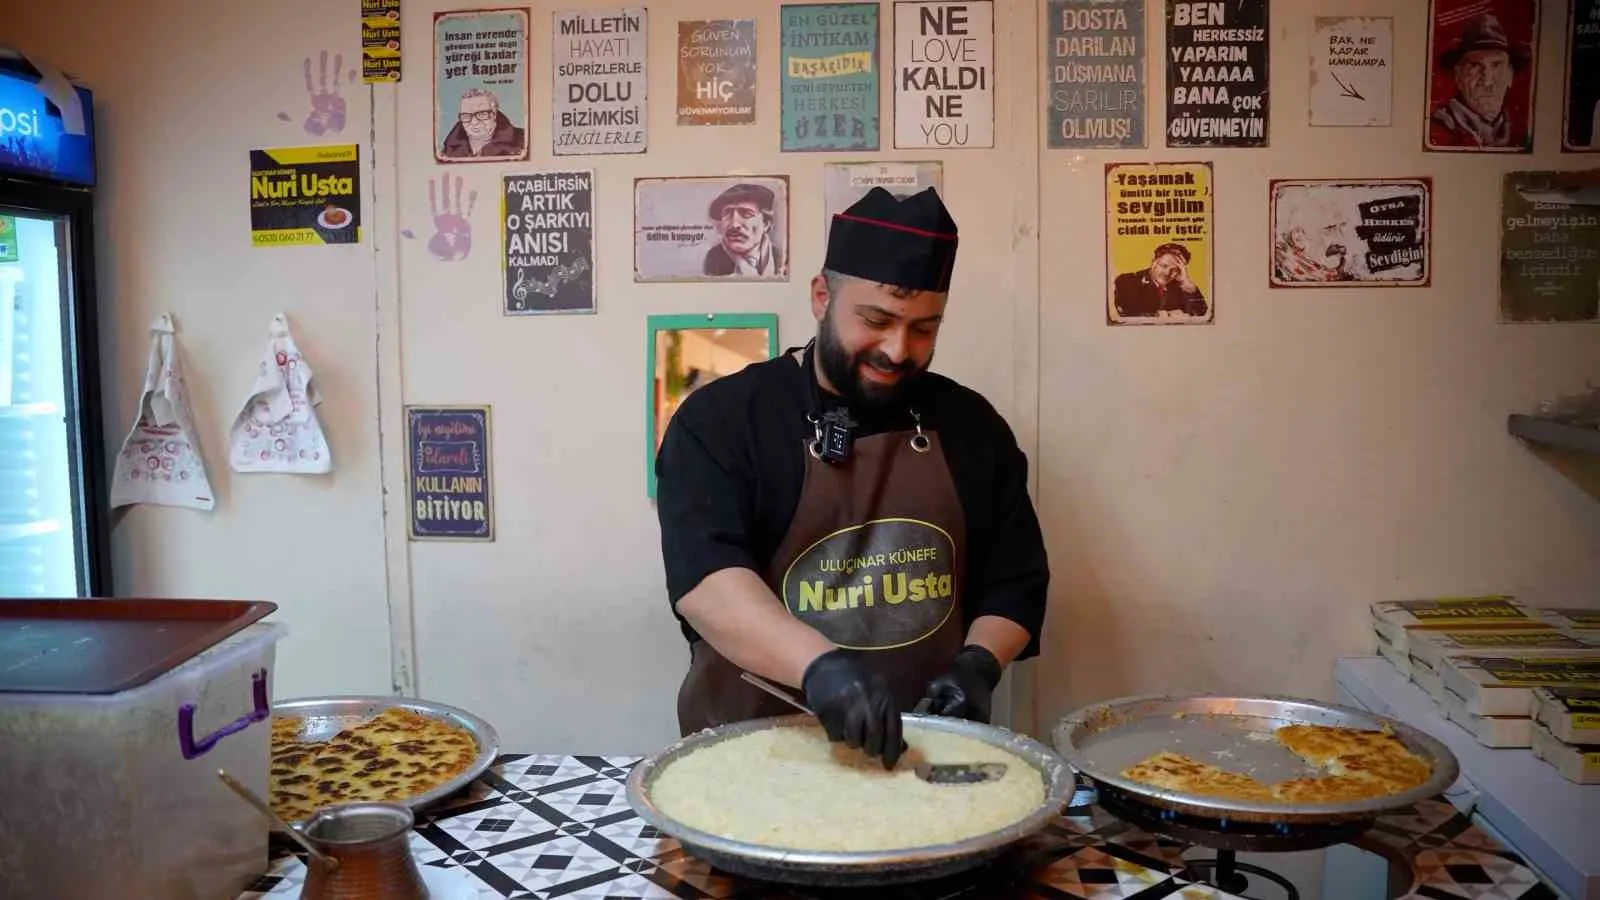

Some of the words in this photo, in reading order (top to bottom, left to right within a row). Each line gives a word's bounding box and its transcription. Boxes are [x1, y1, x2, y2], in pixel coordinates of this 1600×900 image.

[561, 13, 640, 34] MİLLETİN
[789, 16, 809, 26] EN
[920, 6, 968, 36] NE
[1063, 10, 1128, 30] DOSTA
[1174, 3, 1224, 26] BEN
[476, 30, 516, 40] evrende
[692, 30, 739, 42] GÜVEN
[792, 29, 870, 48] İNTİKAM
[1193, 26, 1264, 42] HERKESSİZ
[1330, 36, 1354, 44] BAK
[1360, 36, 1376, 44] NE
[484, 50, 516, 60] kadar
[570, 38, 630, 58] HAYATI
[680, 46, 751, 58] SORUNUM
[912, 38, 976, 62] LOVE
[1056, 36, 1136, 56] DARILAN
[1172, 46, 1248, 62] YAPARIM
[1330, 47, 1368, 56] KADAR
[446, 65, 468, 79] yer
[472, 62, 516, 76] kaplar
[560, 62, 641, 76] SÜPRİZLERLE
[697, 62, 732, 73] YOK
[793, 58, 865, 76] BAŞARIDIR
[1328, 58, 1386, 68] UMRUMDA
[903, 67, 986, 90] KALDI
[1180, 66, 1254, 82] YAAAAA
[568, 82, 632, 103] DOLU
[696, 76, 734, 102] HİÇ
[926, 96, 962, 118] NE
[1056, 90, 1136, 112] SARILIR
[1174, 86, 1230, 104] BANA
[1232, 96, 1262, 112] ÇOK
[562, 106, 639, 126] BİZİMKİSİ
[1172, 112, 1264, 138] GÜVENMEYİN
[558, 131, 642, 146] SİNSİLERLE
[920, 123, 968, 145] YOU
[1062, 118, 1131, 140] OLMUŞ!
[252, 174, 297, 198] Nuri
[301, 173, 352, 196] Usta
[508, 176, 588, 194] AÇABİLİRSİN
[1118, 172, 1194, 186] Yaşamak
[522, 194, 574, 211] ARTIK
[1118, 198, 1204, 216] sevgilim
[508, 214, 520, 230] O
[524, 212, 590, 232] ŞARKIYI
[1118, 225, 1150, 235] ciddi
[1153, 225, 1170, 235] bir
[509, 232, 568, 254] ANISI
[509, 256, 558, 266] KALMADI
[416, 476, 482, 493] KULLANIN
[416, 495, 485, 520] BİTİYOR
[820, 554, 886, 575] ULUÇINAR
[888, 546, 936, 564] KÜNEFE
[799, 575, 874, 612] Nuri
[883, 572, 951, 605] Usta
